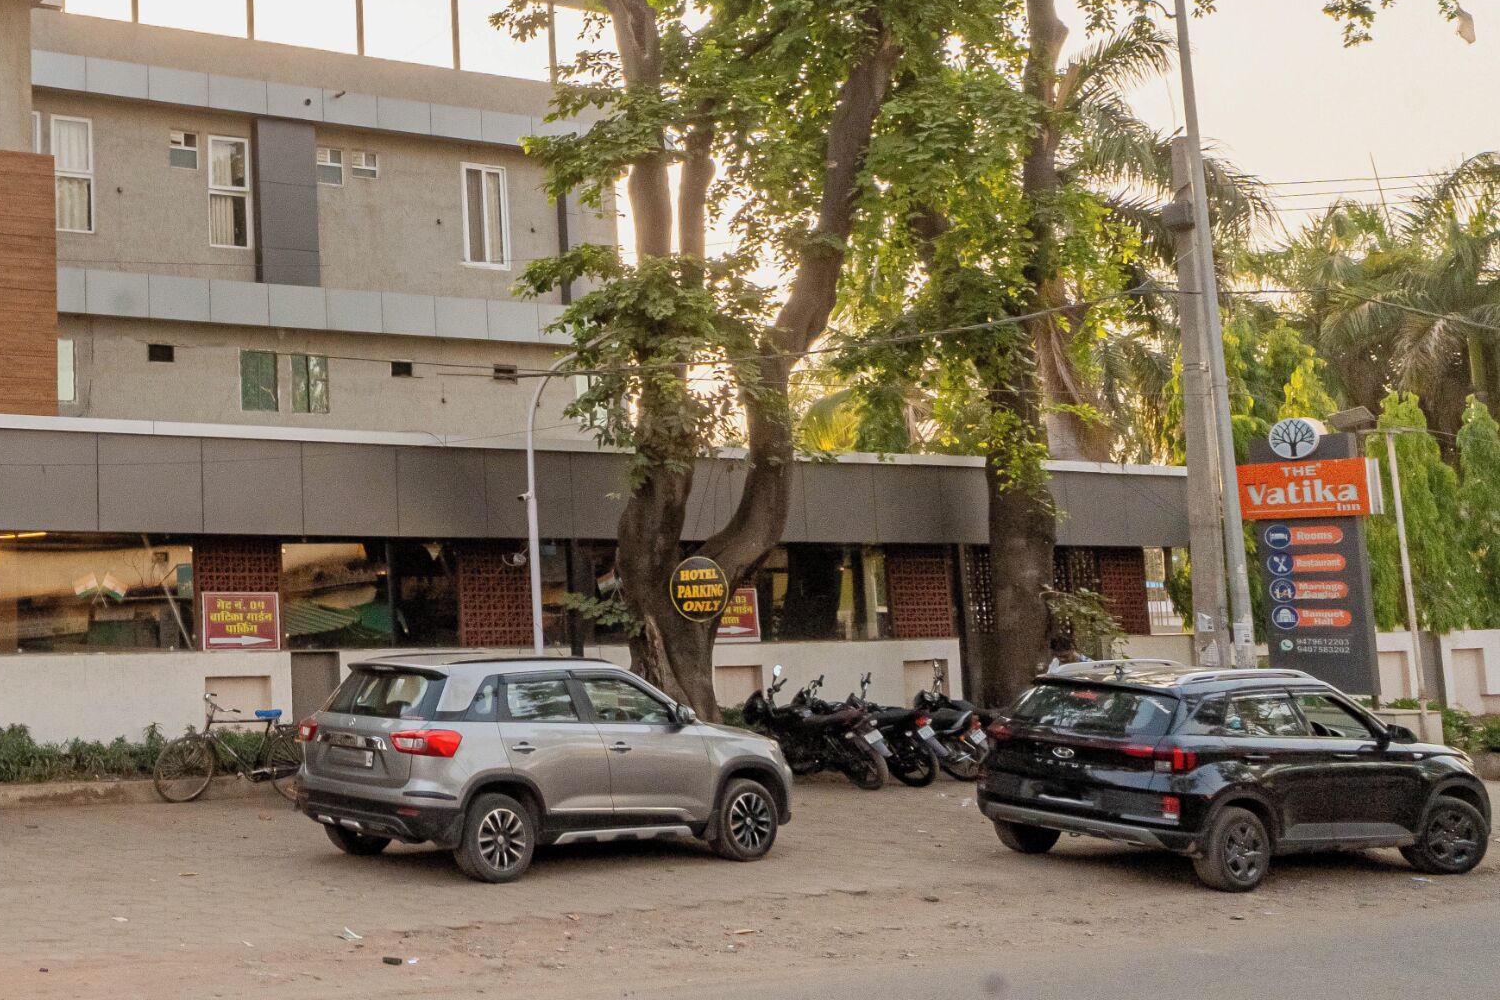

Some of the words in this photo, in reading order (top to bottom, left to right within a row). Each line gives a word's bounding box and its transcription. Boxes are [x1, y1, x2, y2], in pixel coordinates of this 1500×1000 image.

[1281, 465, 1317, 477] THE
[1245, 479, 1359, 505] Vatika
[1336, 503, 1361, 511] Inn
[1296, 532, 1333, 541] Rooms
[1297, 559, 1341, 567] Restaurant
[680, 568, 718, 581] HOTEL
[677, 584, 724, 598] PARKING
[1299, 583, 1343, 591] Marriage
[683, 600, 721, 612] ONLY
[1302, 610, 1344, 618] Banquet
[1314, 617, 1334, 625] Hall
